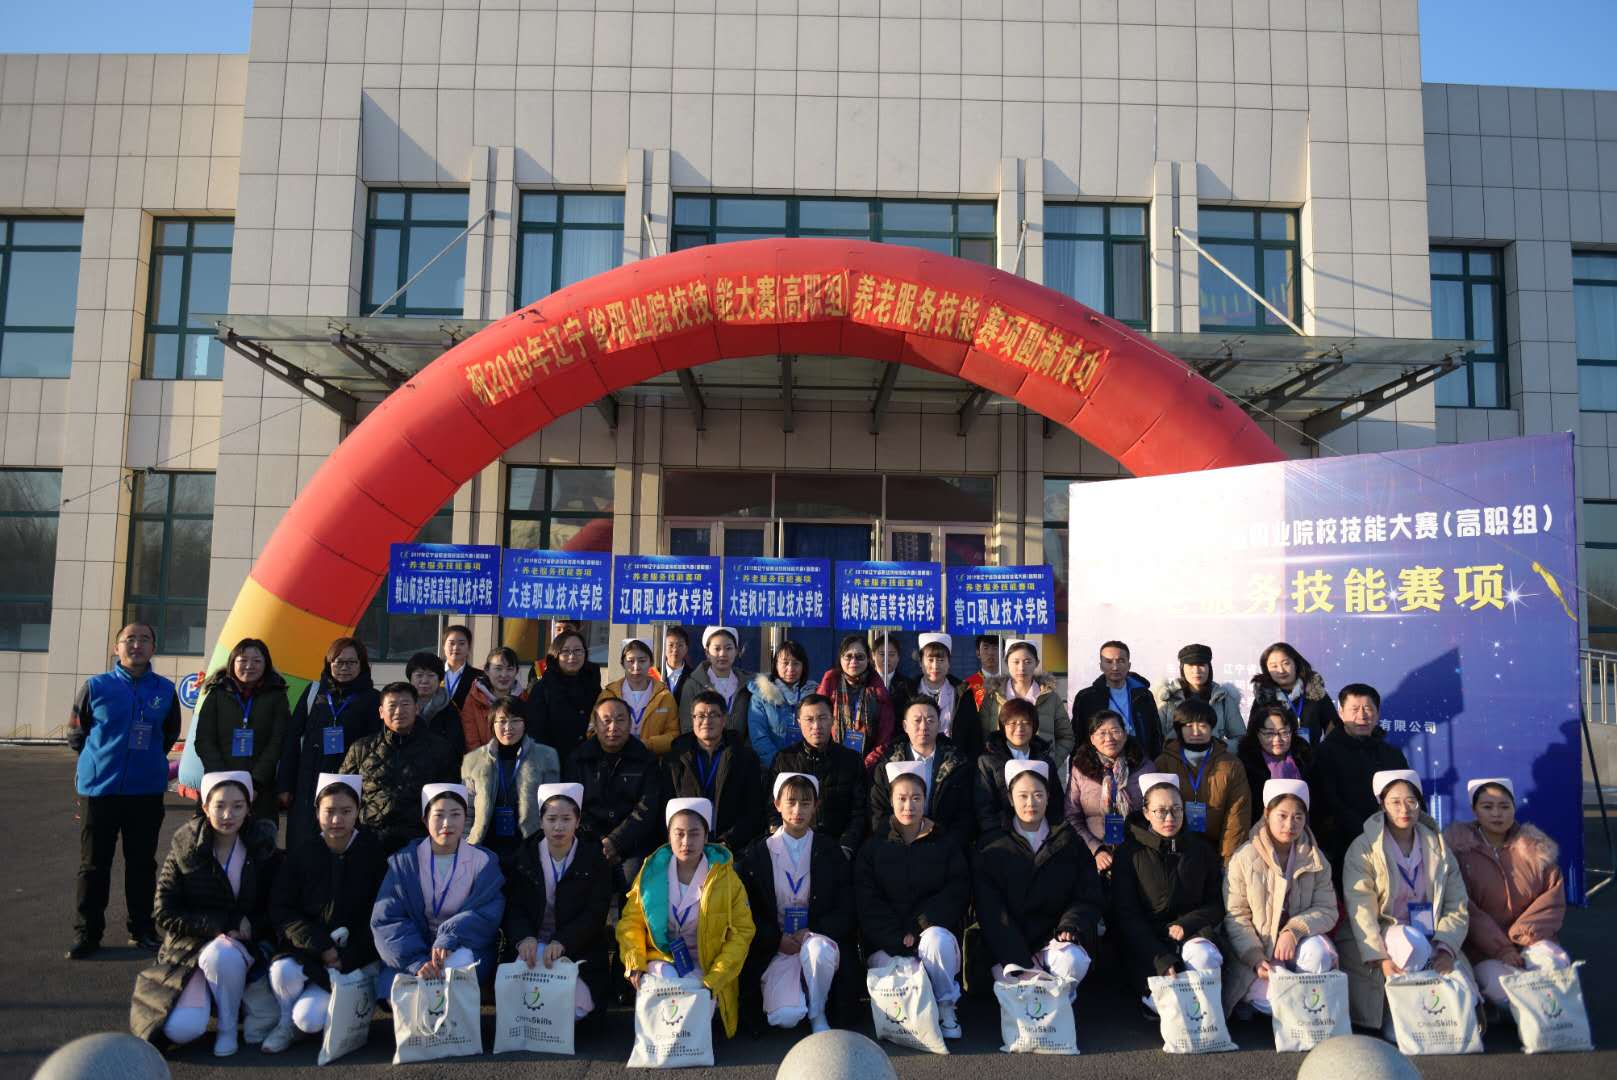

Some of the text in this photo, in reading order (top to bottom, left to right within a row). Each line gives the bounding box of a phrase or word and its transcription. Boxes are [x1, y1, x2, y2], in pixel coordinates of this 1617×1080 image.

[507, 580, 603, 611] 大连职业技术学院
[620, 588, 713, 616] 辽阳职业技术学院
[729, 588, 823, 618] 大连枫叶职业技术学院
[842, 592, 935, 622] 铁岭师范高等专科学校
[954, 597, 1048, 626] 营口职业技术学院
